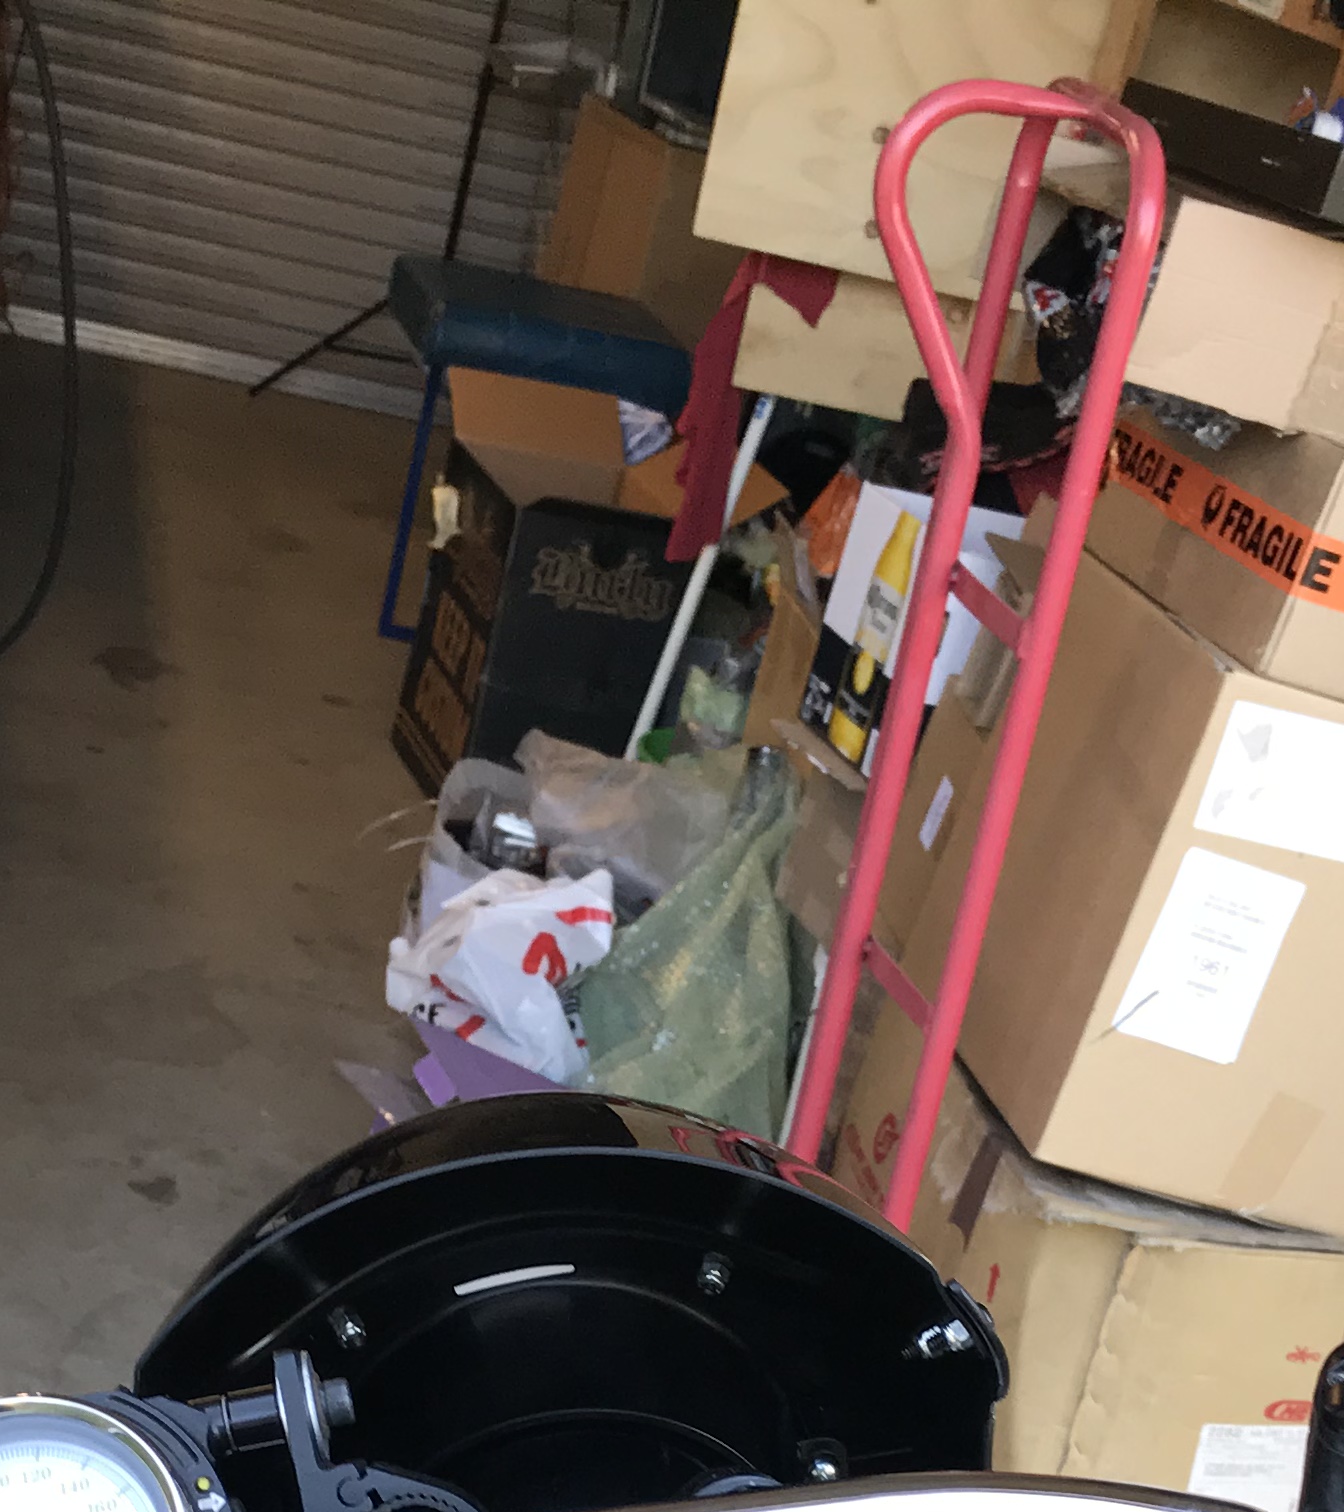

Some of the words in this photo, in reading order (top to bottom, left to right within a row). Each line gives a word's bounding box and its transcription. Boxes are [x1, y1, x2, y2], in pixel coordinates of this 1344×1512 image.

[1113, 428, 1184, 504] RAGILE
[1218, 498, 1342, 593] FRAGILE
[22, 1467, 52, 1484] 120
[60, 1478, 90, 1494] 140
